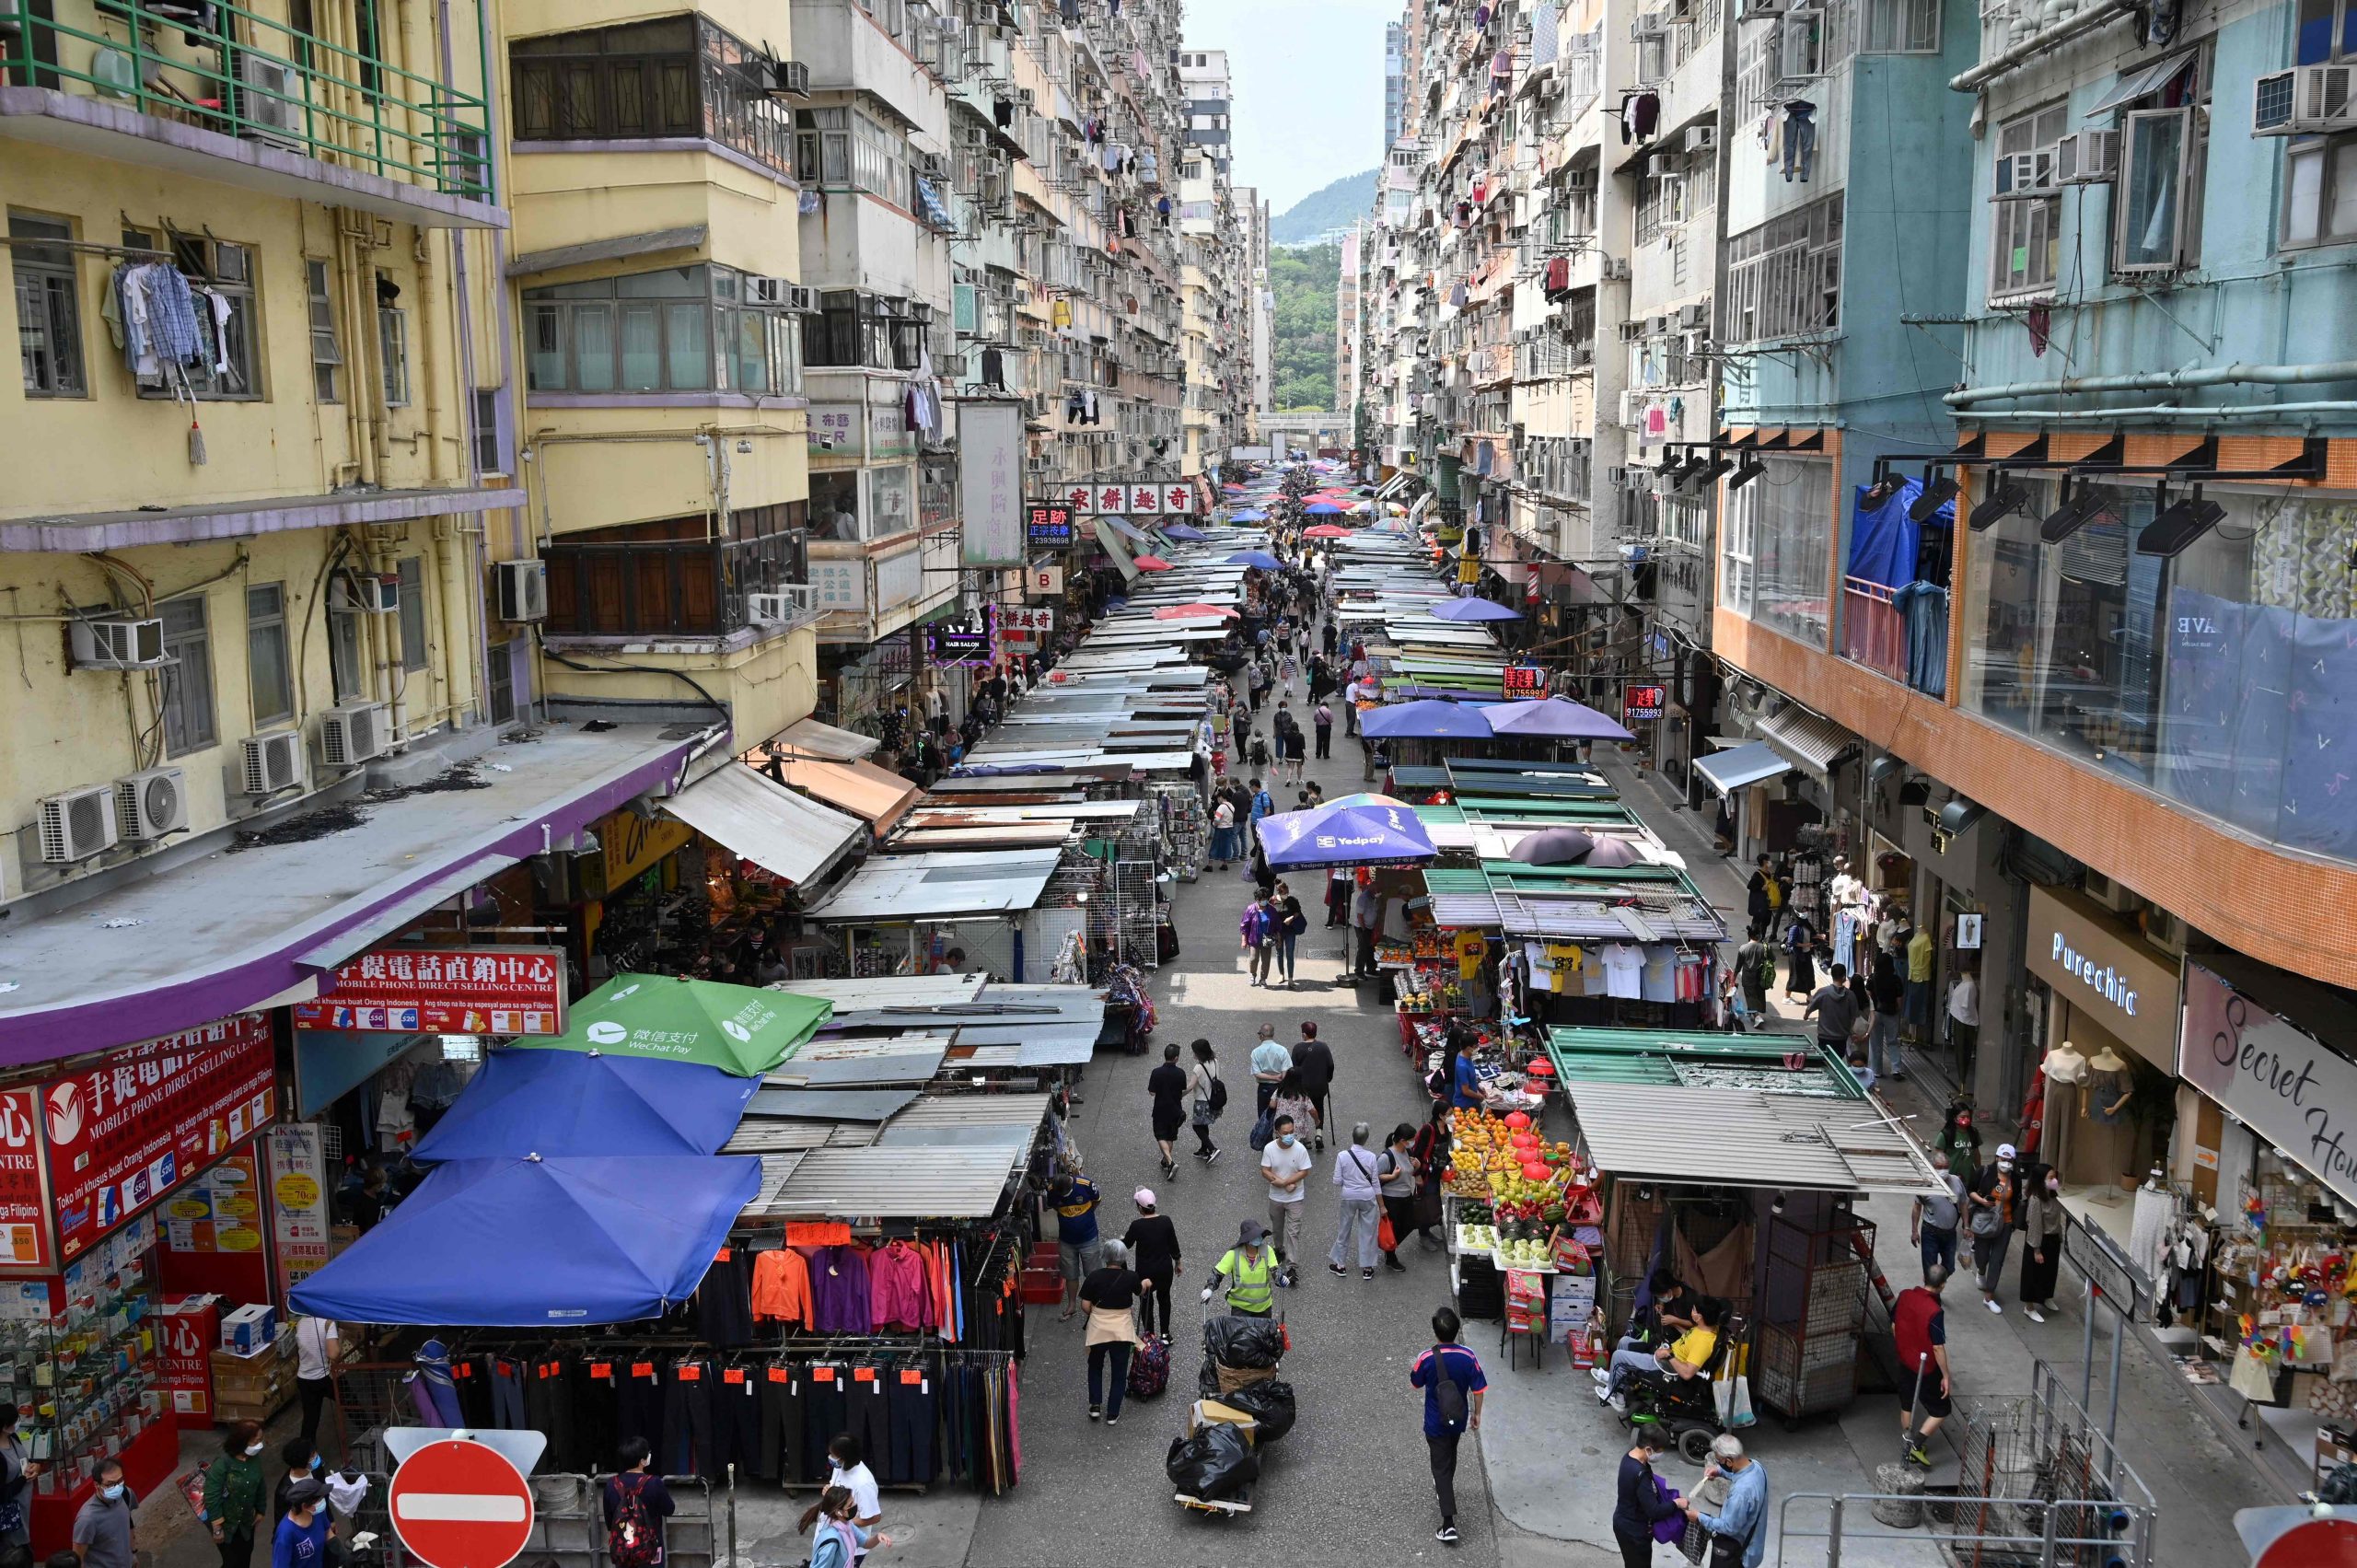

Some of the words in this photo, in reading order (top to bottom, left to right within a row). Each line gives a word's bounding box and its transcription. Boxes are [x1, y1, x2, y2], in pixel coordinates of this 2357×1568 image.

[1031, 509, 1067, 525] 足跡
[1039, 575, 1050, 586] B
[1506, 668, 1534, 688] 美足樂
[1506, 689, 1545, 698] 91755993
[1627, 708, 1663, 717] 91755993
[1338, 834, 1385, 845] Yedpay
[2051, 932, 2136, 1016] Purechic
[336, 981, 377, 989] MOBILE
[379, 981, 416, 990] PHONE
[419, 981, 459, 991] DIRECT
[460, 982, 508, 992] SELLING
[510, 982, 554, 993] CENTRE
[365, 999, 385, 1007] Orang
[749, 1016, 767, 1032] WeChat
[633, 1028, 699, 1045] 微信支付
[629, 1041, 670, 1052] WeChat
[672, 1044, 692, 1055] Pay
[2212, 994, 2320, 1107] Secret
[89, 1109, 130, 1142] MOBILE
[132, 1091, 163, 1117] PHONE
[165, 1072, 198, 1099] DIRECT
[199, 1050, 237, 1078] SELLING
[175, 1123, 185, 1136] Ang
[184, 1116, 196, 1132] shop
[215, 1091, 234, 1113] espesyal
[233, 1086, 243, 1103] para
[257, 1068, 273, 1087] Filipino
[289, 1129, 314, 1137] Mobile
[57, 1194, 74, 1210] Toko
[75, 1184, 83, 1199] ini
[84, 1172, 108, 1193] khusus
[109, 1162, 123, 1179] buat
[124, 1152, 143, 1172] Orang
[143, 1132, 172, 1158] Indonesia
[160, 1162, 173, 1178] $20
[134, 1178, 147, 1196] $50
[10, 1203, 39, 1219] Filipino
[158, 1359, 203, 1371] CENTRE
[168, 1376, 181, 1386] mga
[181, 1375, 204, 1385] Filipino
